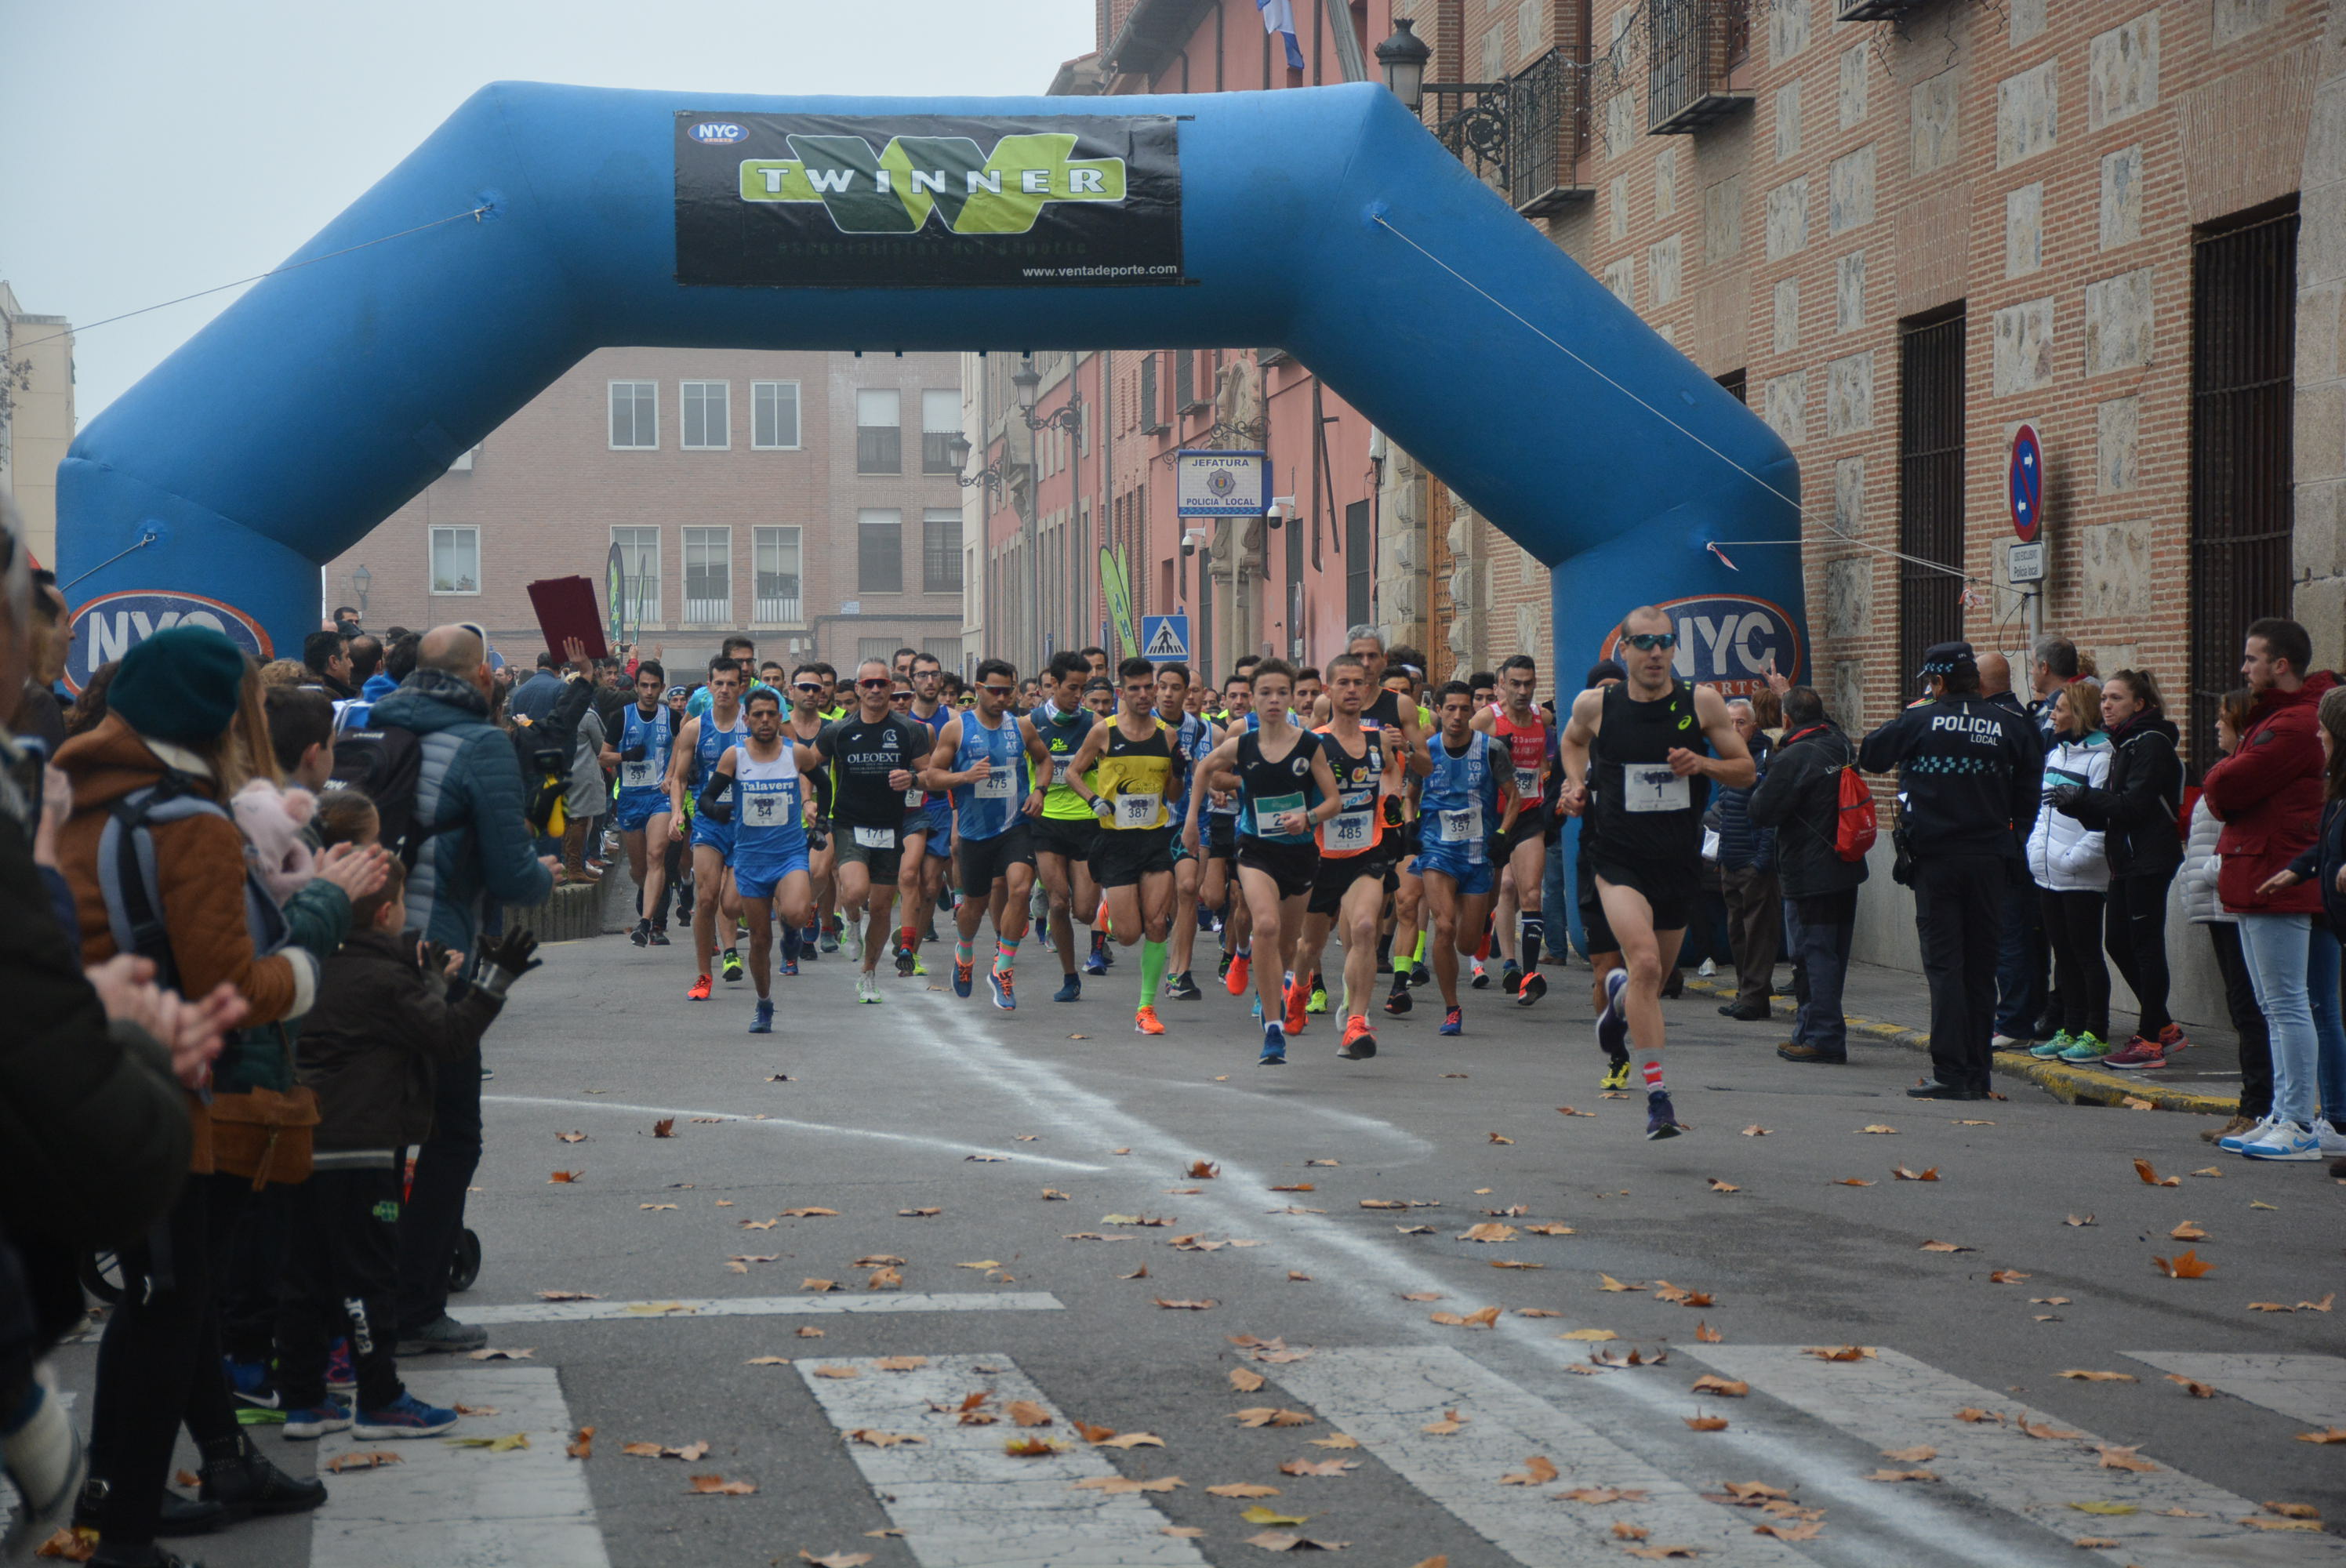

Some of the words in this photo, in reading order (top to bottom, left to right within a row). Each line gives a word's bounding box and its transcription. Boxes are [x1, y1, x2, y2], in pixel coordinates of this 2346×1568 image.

[699, 125, 739, 138] NYC
[757, 167, 1106, 194] TWINNER
[1022, 265, 1177, 278] www.ventadeporte.com
[1932, 716, 2003, 736] POLICIA
[1970, 734, 1999, 746] LOCAL
[847, 752, 902, 764] OLEOEXT
[986, 779, 1007, 789] 475
[1654, 784, 1661, 798] 1
[757, 807, 772, 817] 54
[1128, 808, 1148, 818] 387
[1451, 821, 1470, 832] 357
[1338, 827, 1361, 839] 485
